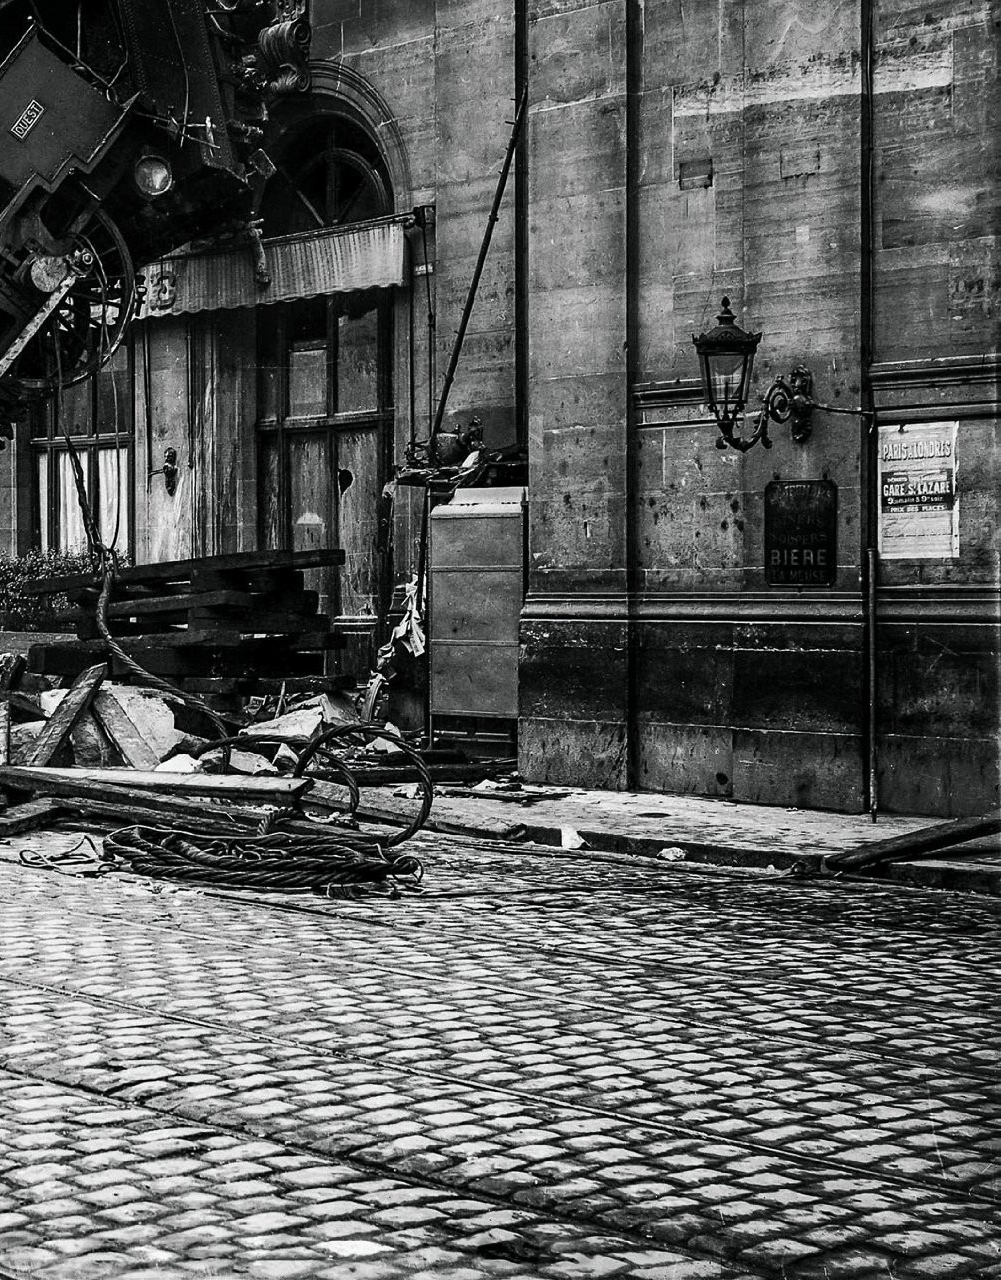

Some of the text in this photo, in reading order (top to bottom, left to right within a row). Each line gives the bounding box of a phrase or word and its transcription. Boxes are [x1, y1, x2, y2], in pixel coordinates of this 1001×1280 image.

[15, 104, 40, 135] OUEST
[883, 443, 907, 461] PARIS
[914, 440, 952, 459] LONDRES
[883, 484, 905, 497] GARE
[917, 481, 951, 495] LAZARE
